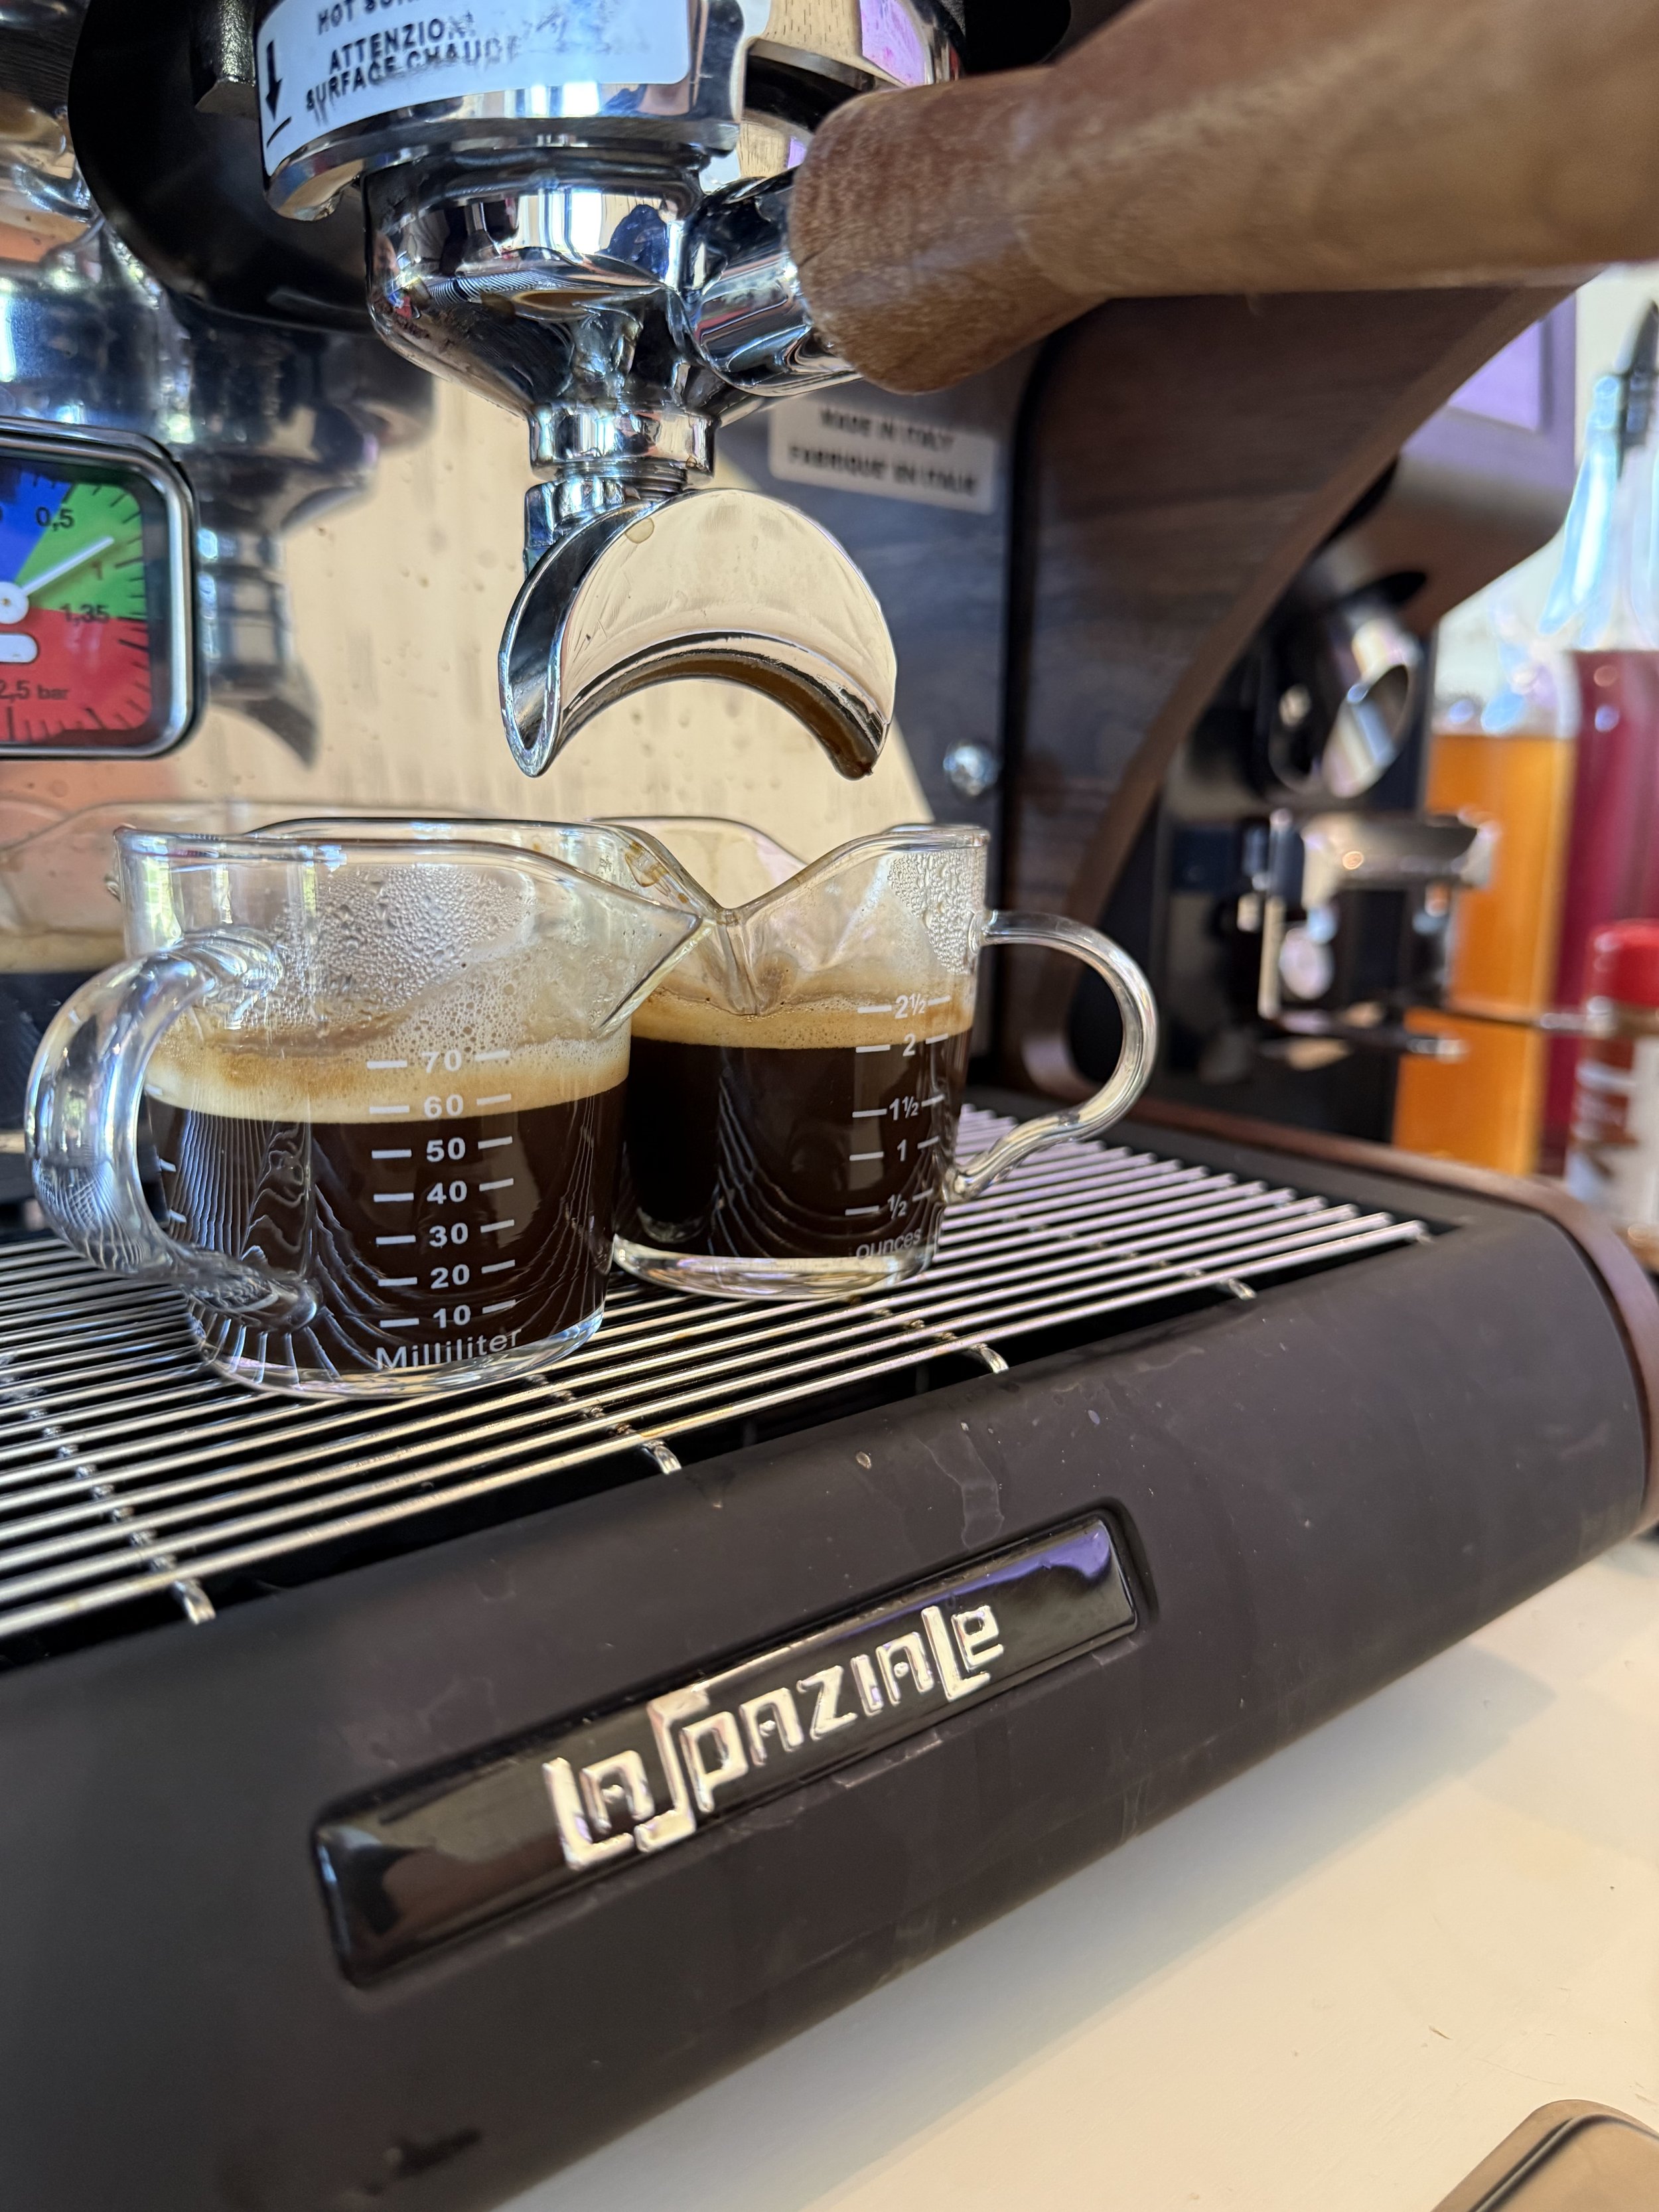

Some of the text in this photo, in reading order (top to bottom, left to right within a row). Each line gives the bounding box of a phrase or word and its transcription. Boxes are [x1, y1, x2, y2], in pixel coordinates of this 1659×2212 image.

[306, 54, 399, 111] SURFACE
[35, 506, 74, 532] 0,5
[60, 603, 110, 626] 1,35
[902, 1033, 916, 1057] 2
[421, 1049, 463, 1074] 70
[423, 1094, 465, 1120] 60
[426, 1137, 466, 1163] 50
[896, 1139, 907, 1162] 1
[426, 1180, 468, 1205] 40
[429, 1222, 469, 1248] 30
[430, 1264, 470, 1289] 20
[433, 1304, 471, 1329] 10
[376, 1327, 522, 1371] Milliliter
